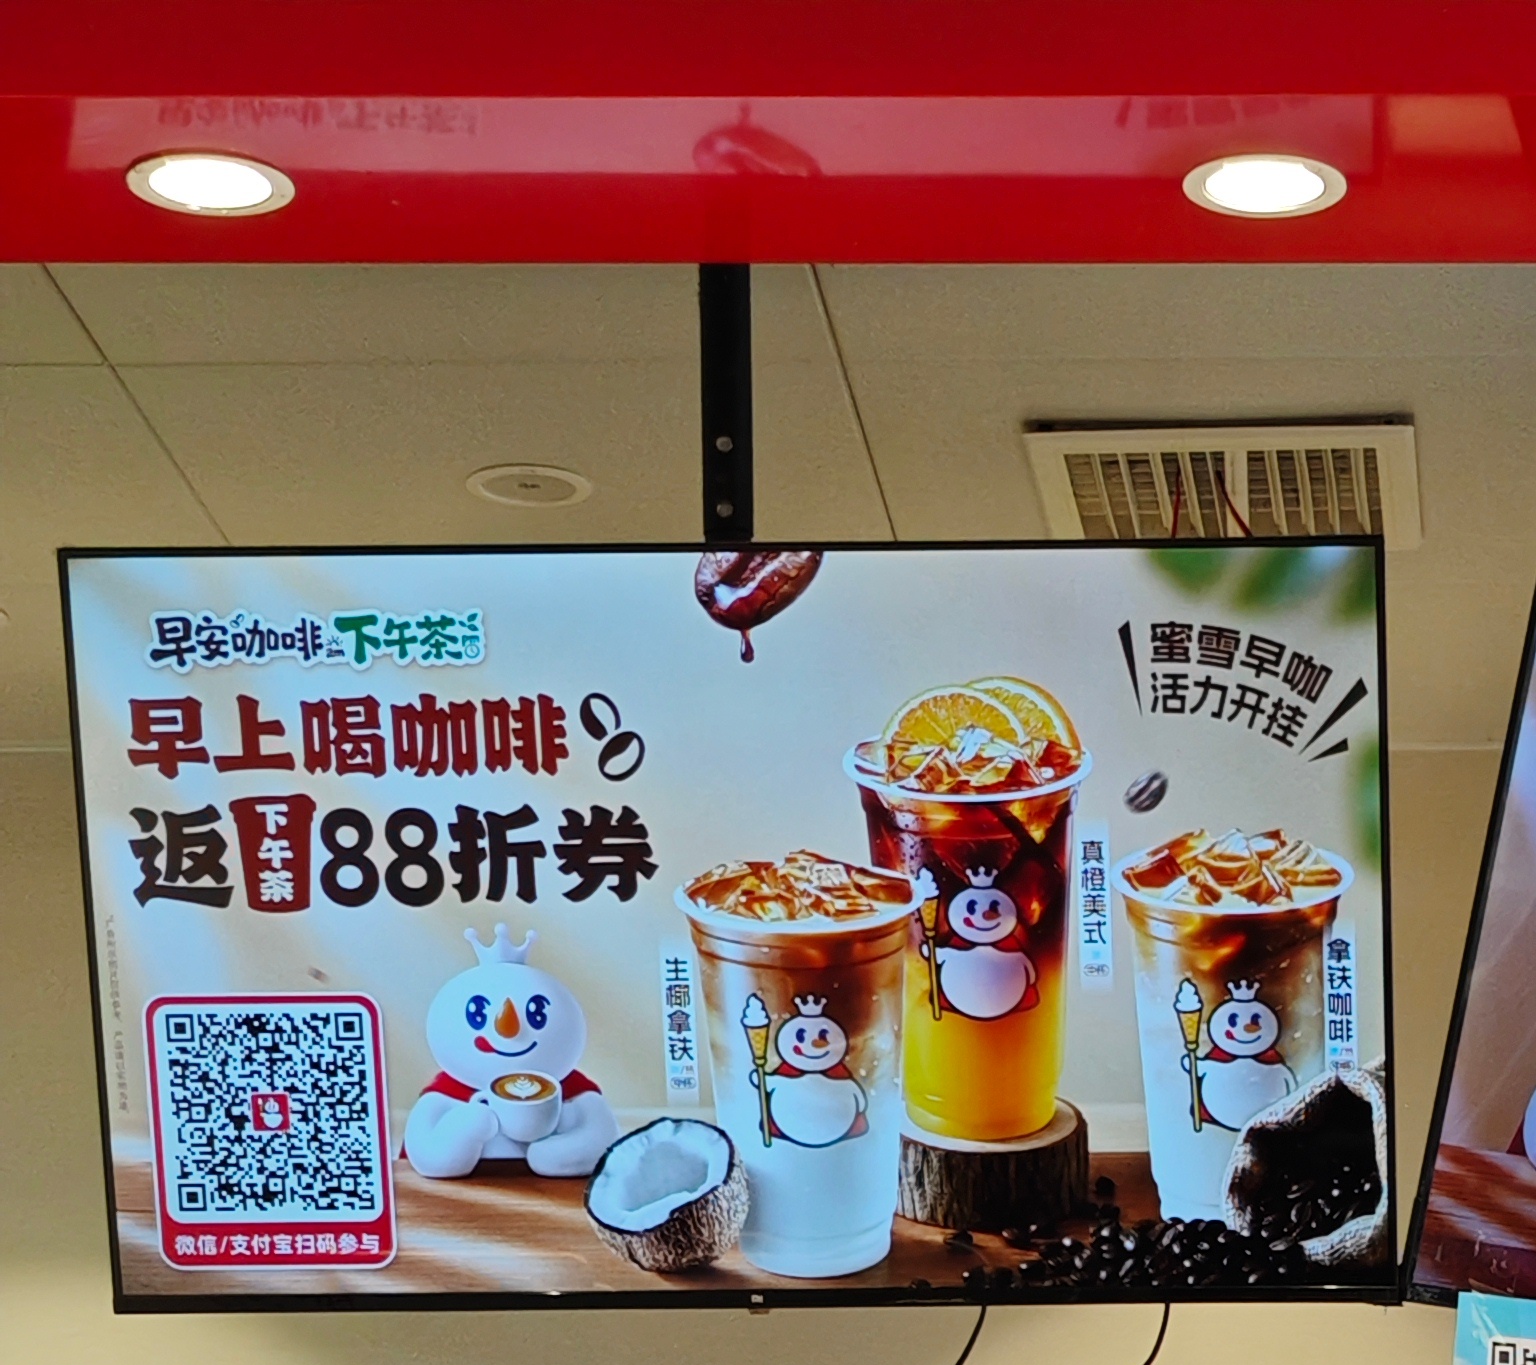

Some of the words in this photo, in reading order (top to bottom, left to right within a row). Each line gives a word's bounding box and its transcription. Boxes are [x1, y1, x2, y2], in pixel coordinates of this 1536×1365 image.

[334, 614, 462, 665] 下午茶
[1150, 620, 1334, 704] 蜜雪早咖
[127, 693, 570, 779] 早上喝咖啡
[1150, 671, 1309, 748] 活力开挂
[129, 806, 235, 909] 返
[254, 803, 295, 904] 下午茶
[319, 804, 660, 909] 88折券
[1081, 840, 1107, 945] 真橙美式
[665, 957, 695, 1062] 生椰拿铁
[1327, 938, 1354, 1043] 拿铁咖啡
[174, 1233, 381, 1258] 微信/支付宝扫码参与
